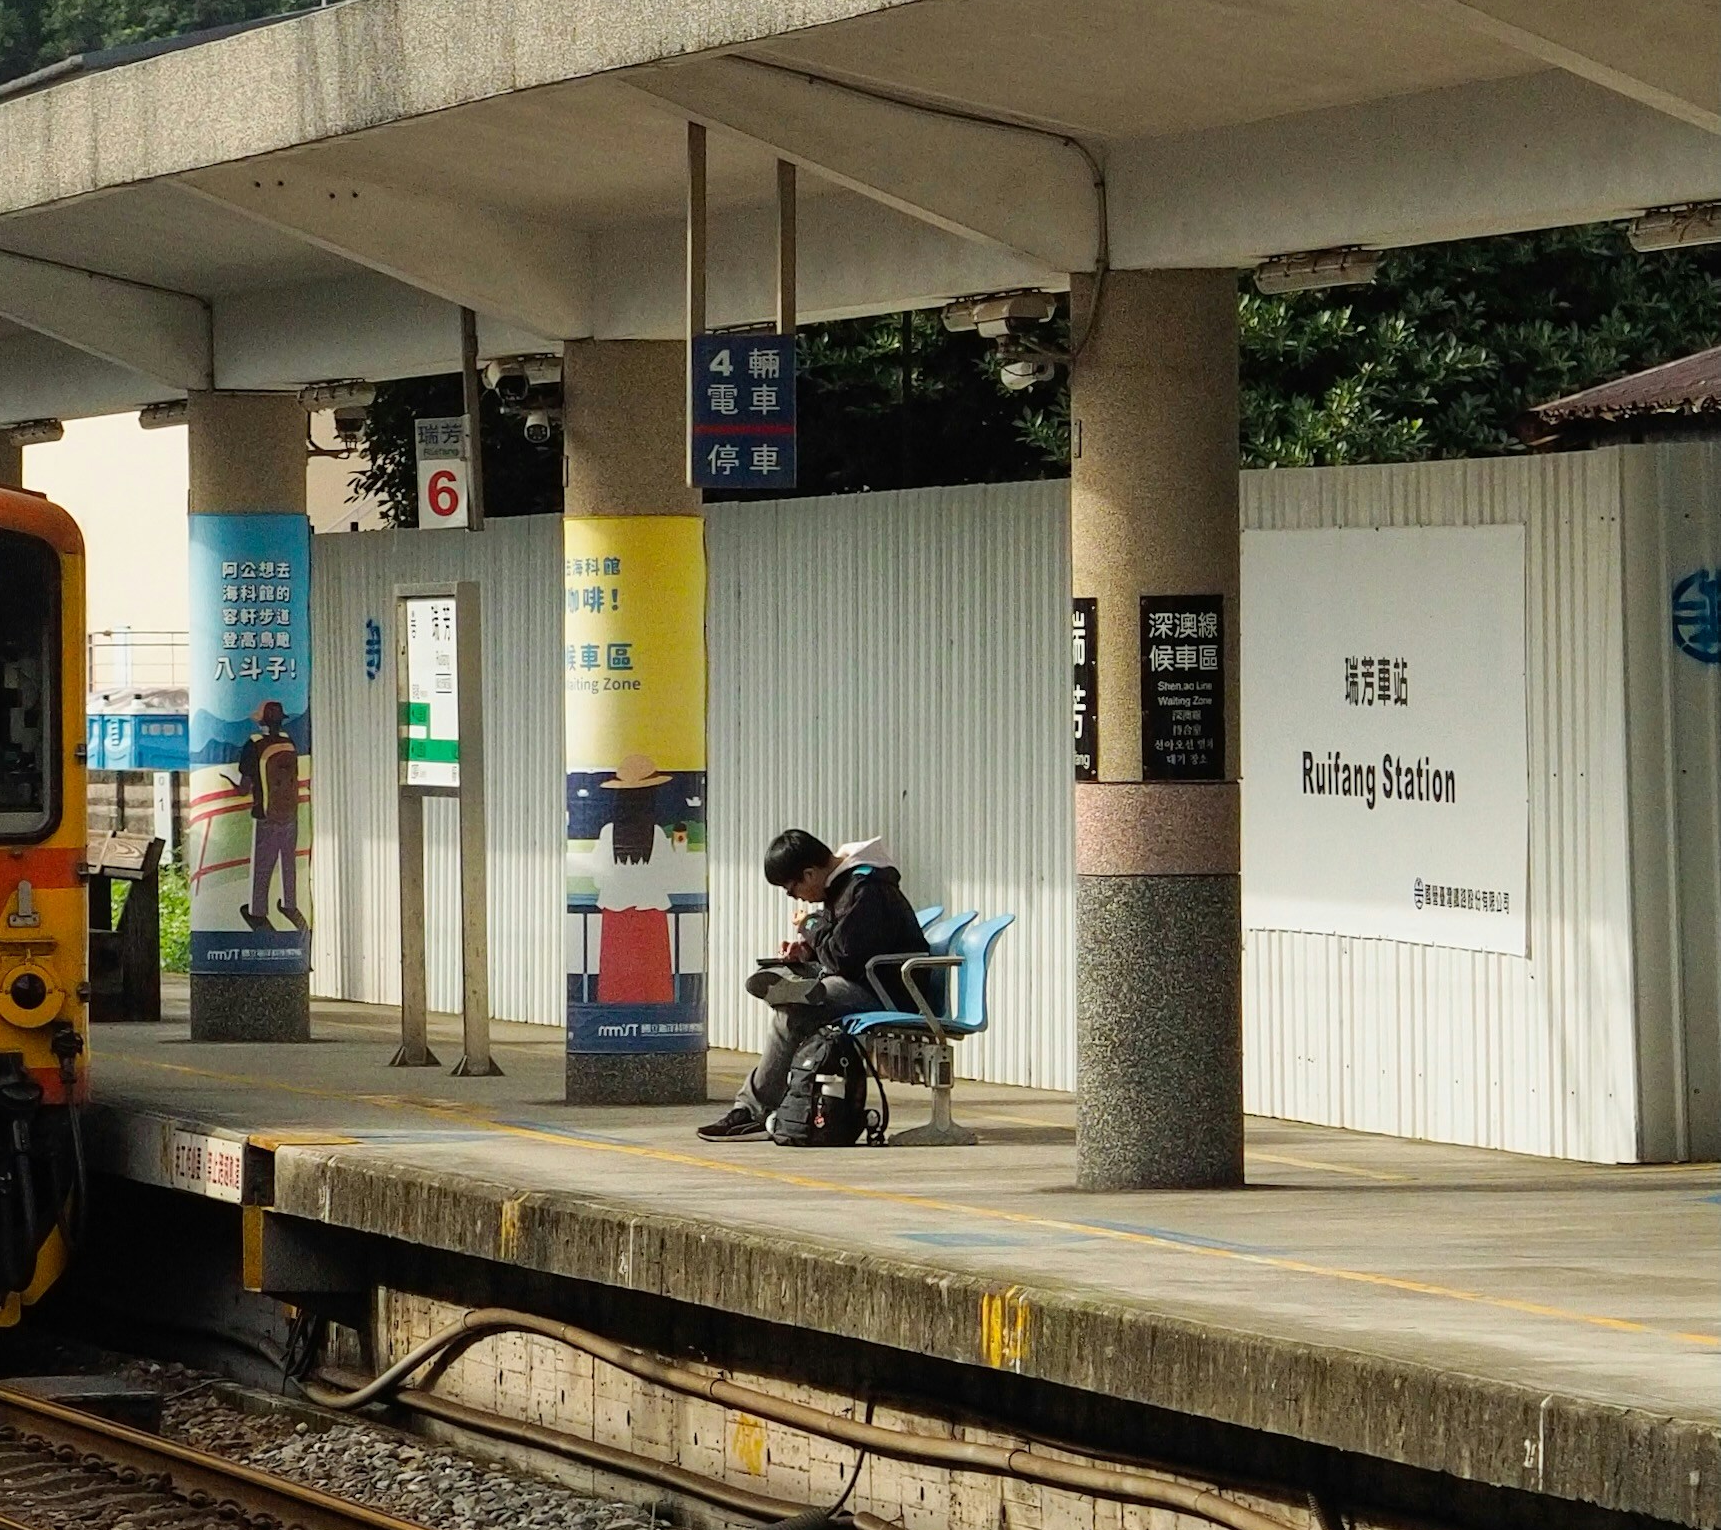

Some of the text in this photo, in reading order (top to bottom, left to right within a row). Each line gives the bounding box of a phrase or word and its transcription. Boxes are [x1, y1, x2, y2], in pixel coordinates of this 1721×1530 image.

[707, 384, 781, 415] 電車
[418, 423, 462, 444] 瑞芳
[707, 443, 781, 475] 停車
[428, 470, 458, 517] 6
[222, 560, 291, 579] 阿公想去
[222, 584, 291, 602] 海科館的
[222, 608, 291, 625] 容軒步道
[1148, 612, 1218, 639] 深澳線
[214, 655, 297, 680] 八斗子!
[1148, 644, 1219, 672] 候車區
[603, 677, 641, 691] Zone
[1196, 681, 1213, 691] Line
[1345, 655, 1408, 707] 瑞芳車站
[1157, 695, 1213, 708] Waiting Zone
[1302, 750, 1456, 810] Ruifang Station
